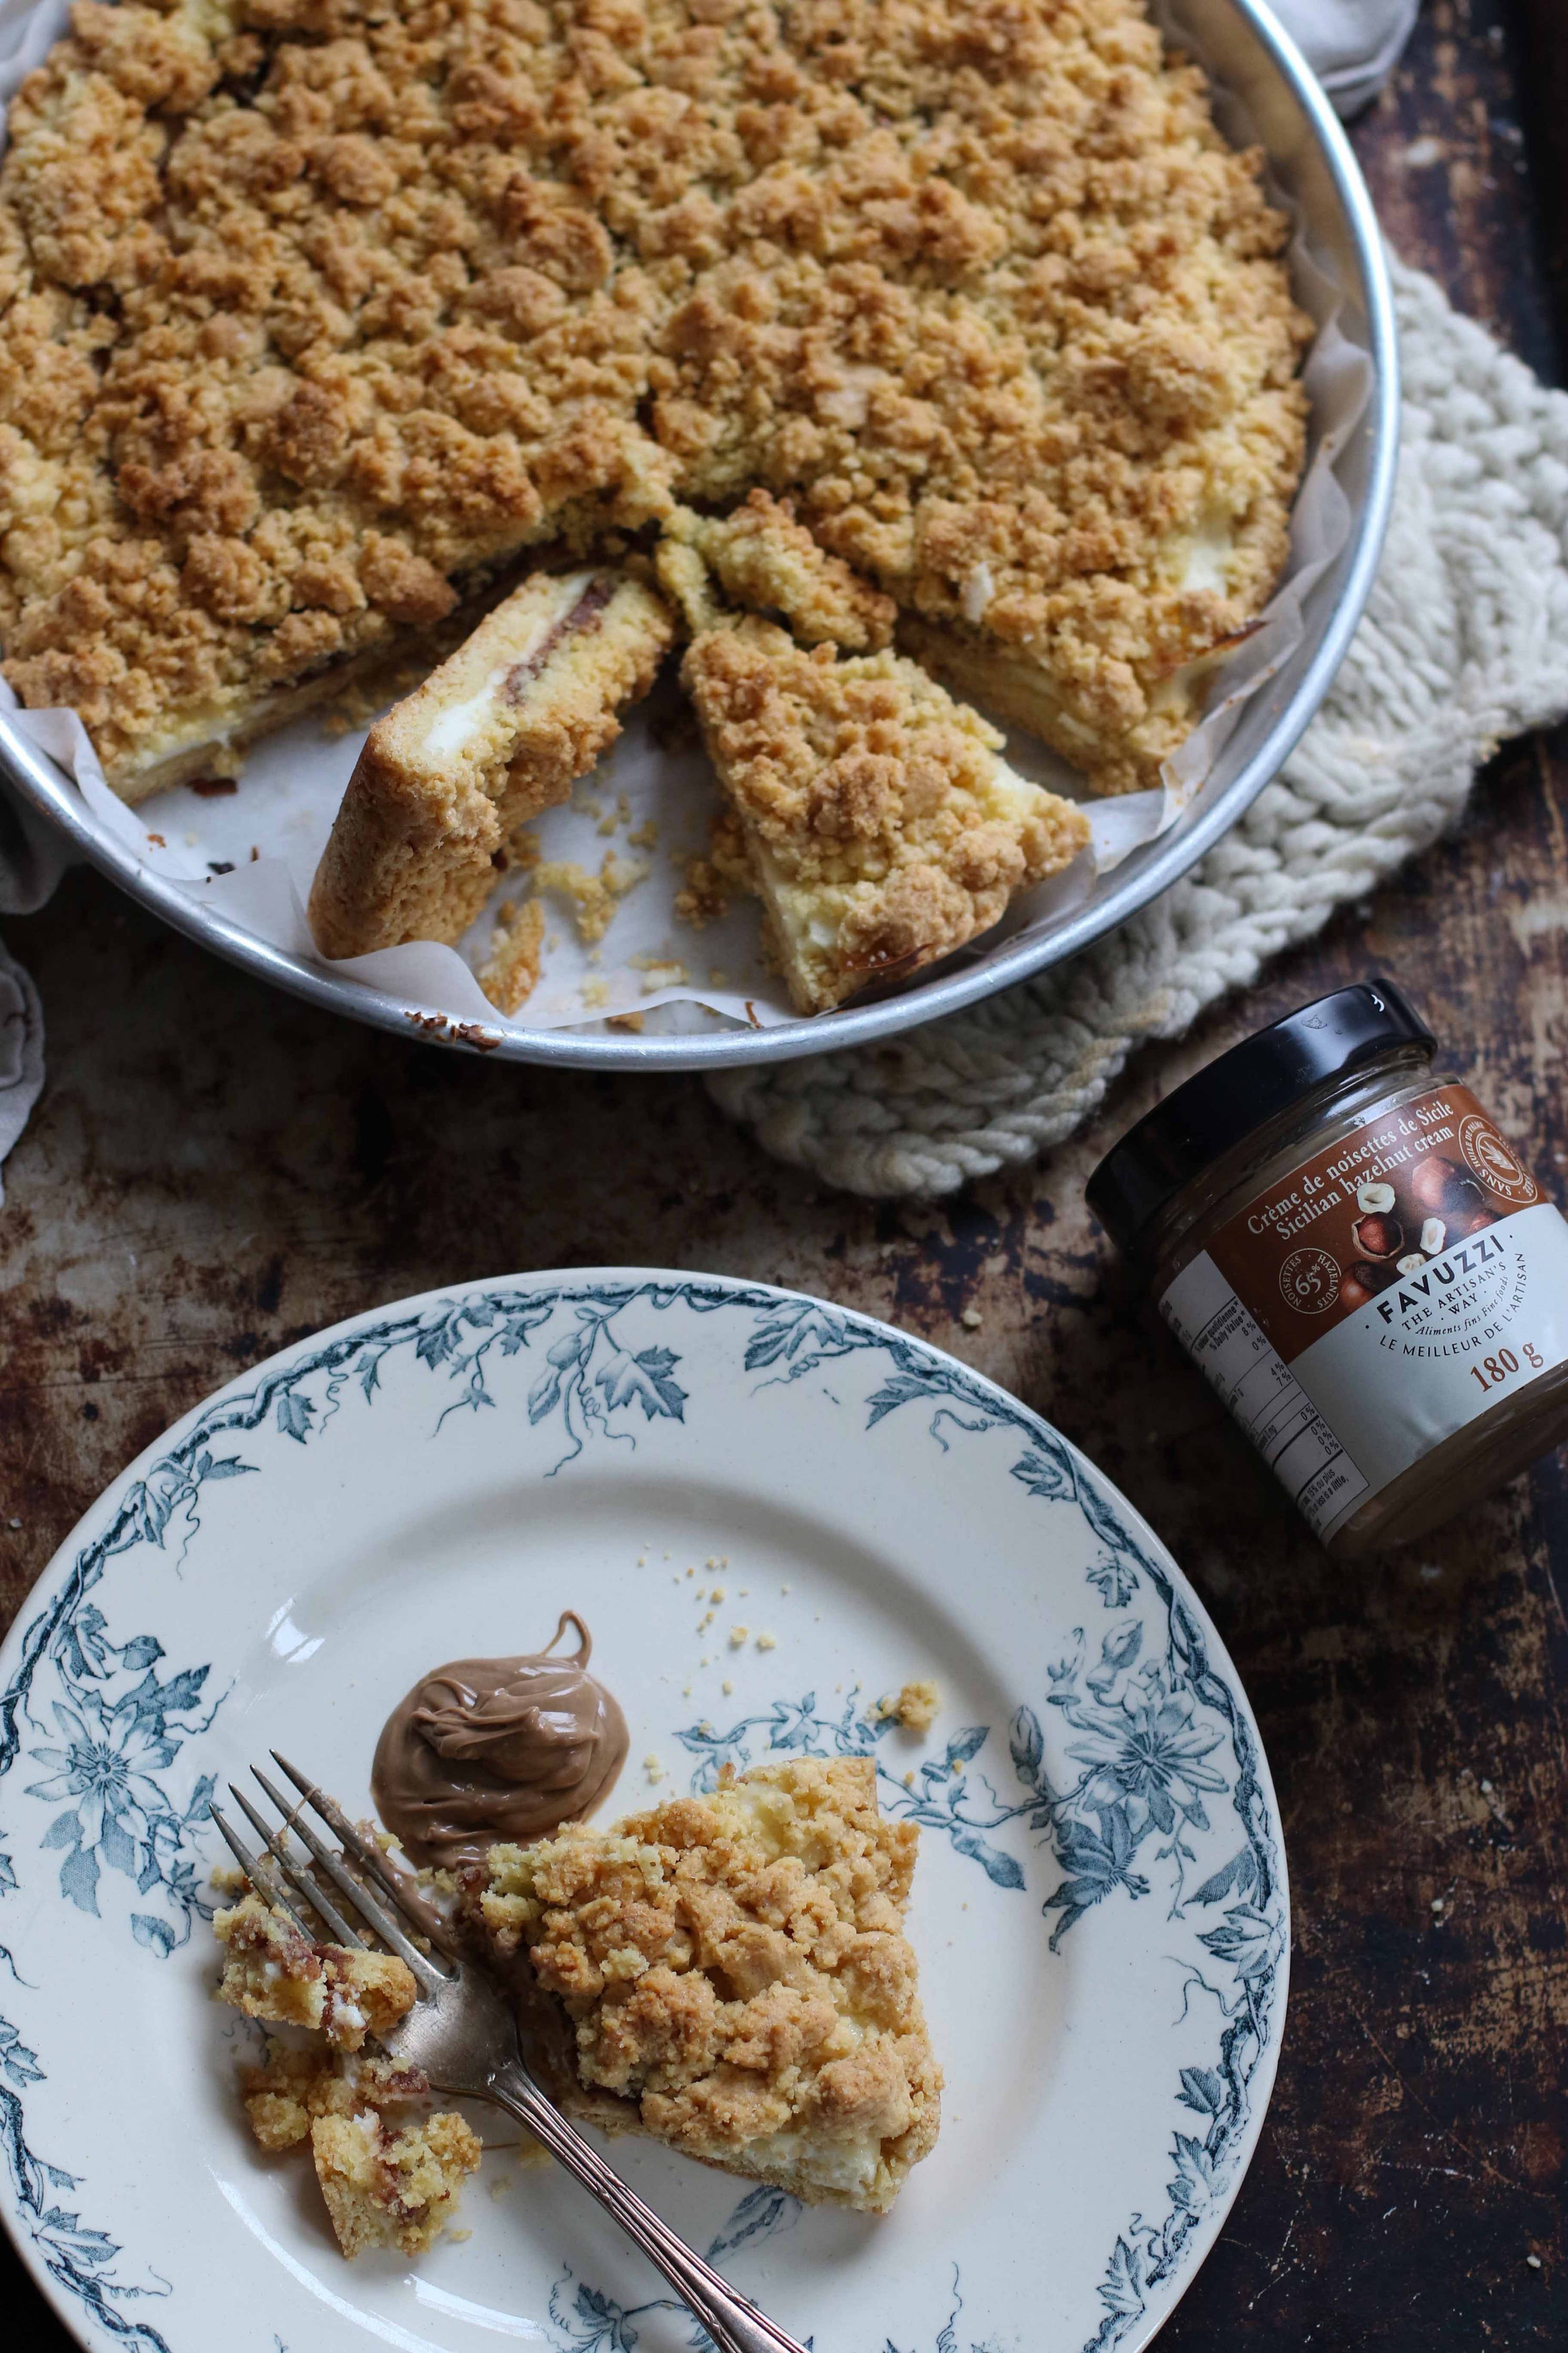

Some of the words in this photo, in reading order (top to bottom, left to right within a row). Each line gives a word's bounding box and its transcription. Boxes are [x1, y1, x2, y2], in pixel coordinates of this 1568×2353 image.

[1248, 1192, 1301, 1234] Crème
[1302, 1175, 1324, 1195] de
[1326, 1131, 1397, 1180] noisettes
[1398, 1118, 1418, 1136] de
[1415, 1101, 1453, 1126] Sicile
[1465, 1142, 1481, 1168] HUILE
[1277, 1191, 1342, 1240] Sicilian
[1339, 1145, 1413, 1195] hazelnut
[1414, 1127, 1454, 1152] cream
[1480, 1169, 1511, 1195] SANS
[1283, 1255, 1301, 1306] NOISETTES
[1317, 1254, 1338, 1308] HAZELNUTS
[1377, 1235, 1504, 1324] FAVUZZI
[1380, 1335, 1397, 1350] LE
[1403, 1336, 1482, 1357] MEILLEUR
[1484, 1322, 1503, 1339] DE
[1502, 1253, 1526, 1322] L'ARTISAN
[1415, 1324, 1461, 1335] Aliments
[1464, 1316, 1481, 1331] fins
[1482, 1299, 1498, 1316] Fine
[1495, 1276, 1508, 1301] foods
[1448, 1293, 1478, 1314] WAY
[1402, 1308, 1432, 1331] THE
[1471, 1349, 1519, 1392] 180
[1523, 1343, 1543, 1368] g
